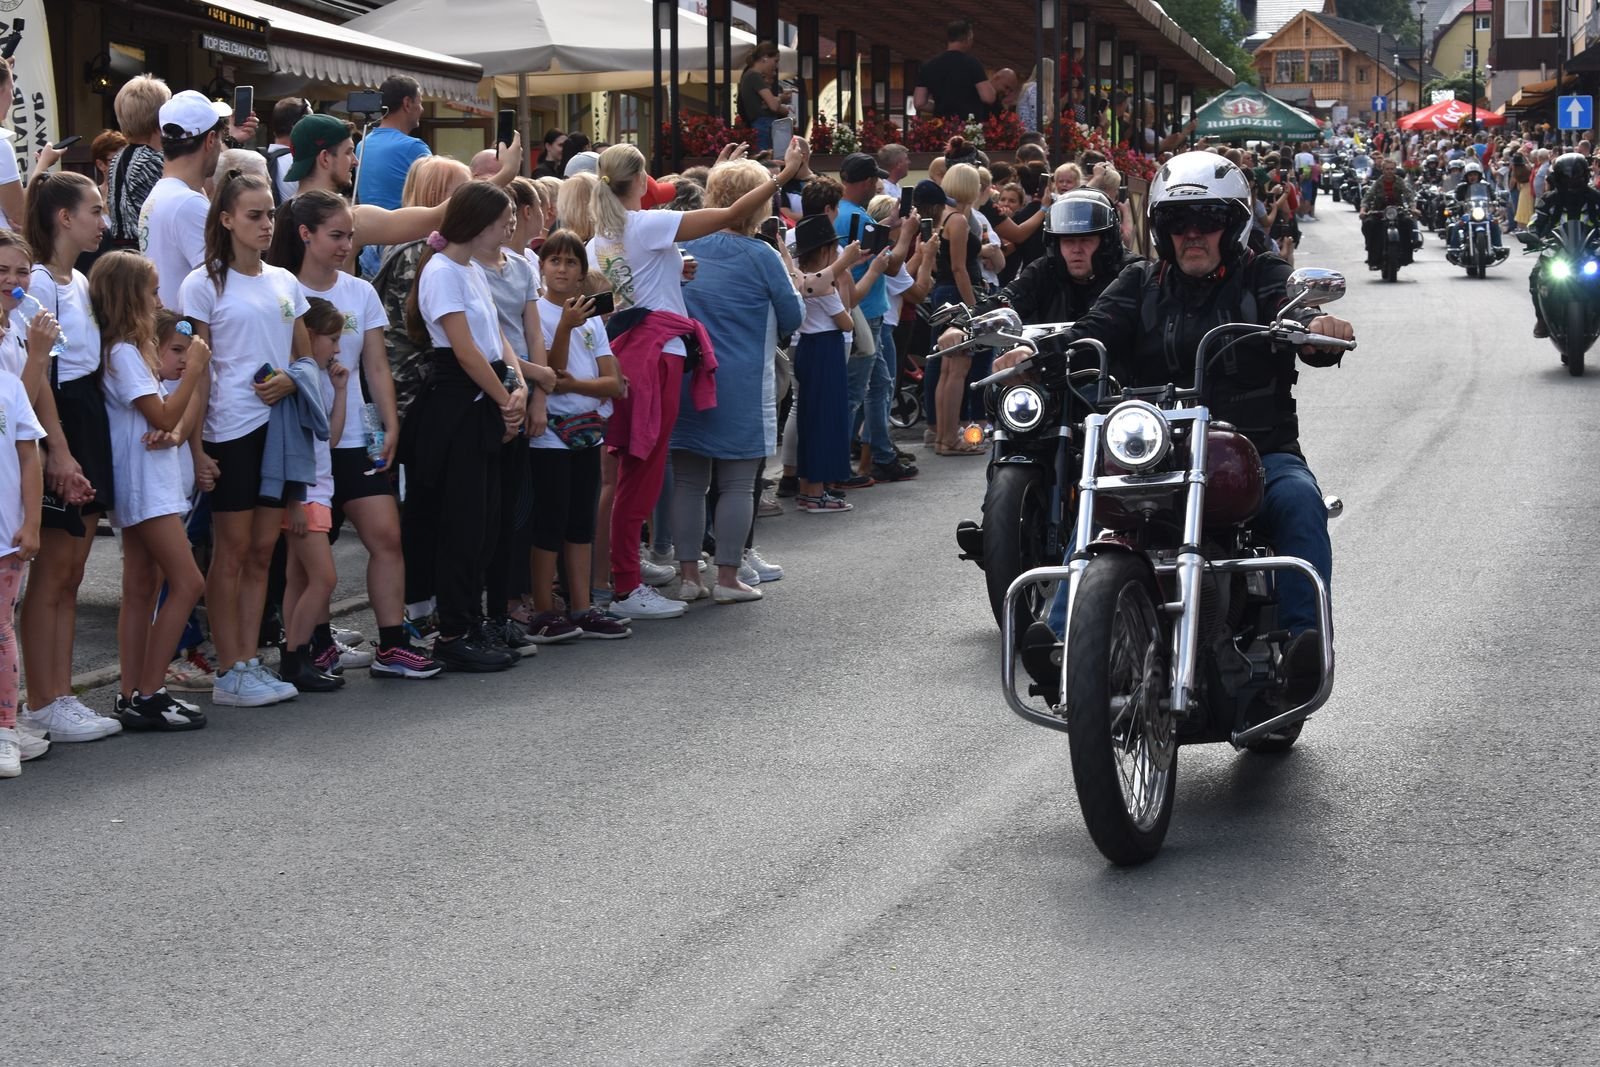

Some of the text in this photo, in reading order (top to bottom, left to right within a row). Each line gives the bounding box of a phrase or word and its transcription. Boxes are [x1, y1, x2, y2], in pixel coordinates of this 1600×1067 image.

[203, 35, 218, 49] TOP
[219, 39, 247, 57] BELGIAN
[1207, 117, 1283, 129] ROHOZEC
